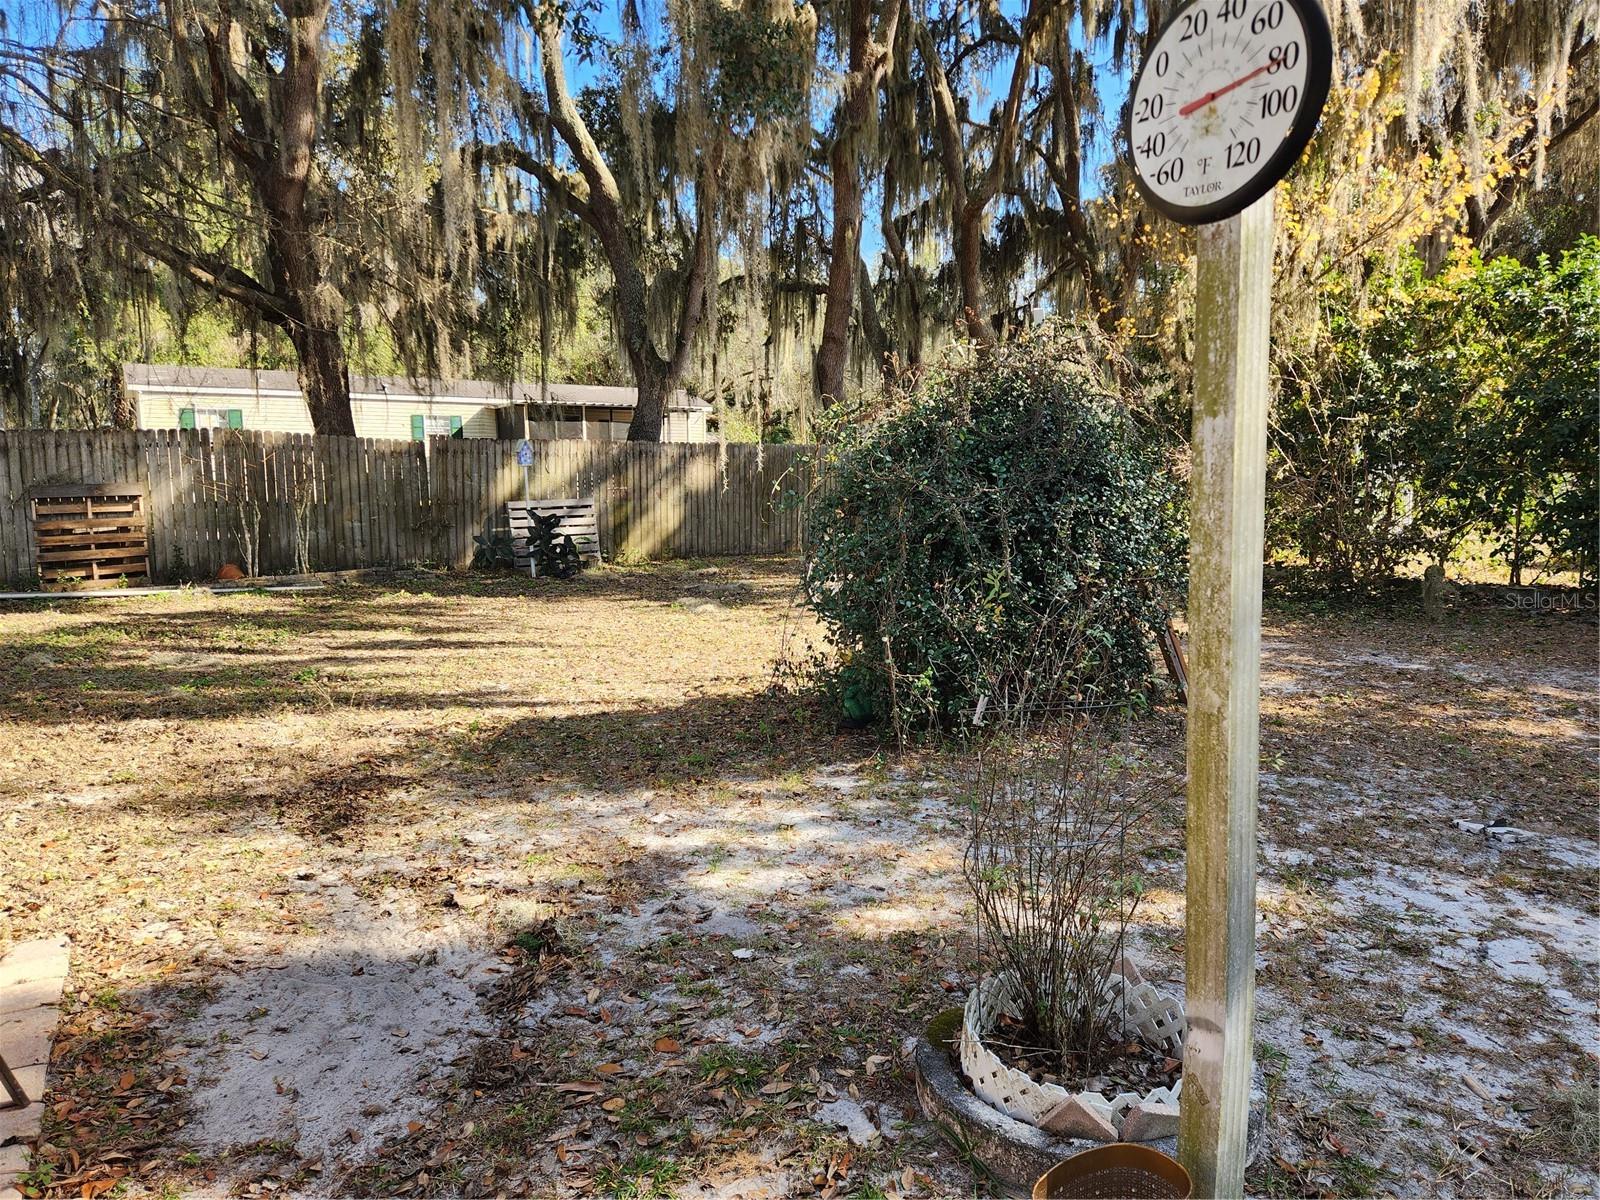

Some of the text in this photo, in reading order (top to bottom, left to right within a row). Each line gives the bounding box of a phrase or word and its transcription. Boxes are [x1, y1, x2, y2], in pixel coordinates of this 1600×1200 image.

[1179, 9, 1209, 42] 20
[1217, 0, 1247, 23] 40
[1251, 1, 1284, 35] 60
[1156, 51, 1169, 77] 0
[1266, 41, 1300, 75] 80
[1135, 94, 1164, 123] -20
[1259, 85, 1298, 119] 100
[1136, 132, 1166, 159] -40
[1224, 137, 1261, 169] 120
[1150, 157, 1184, 185] -60
[1183, 181, 1223, 198] TAYLOR
